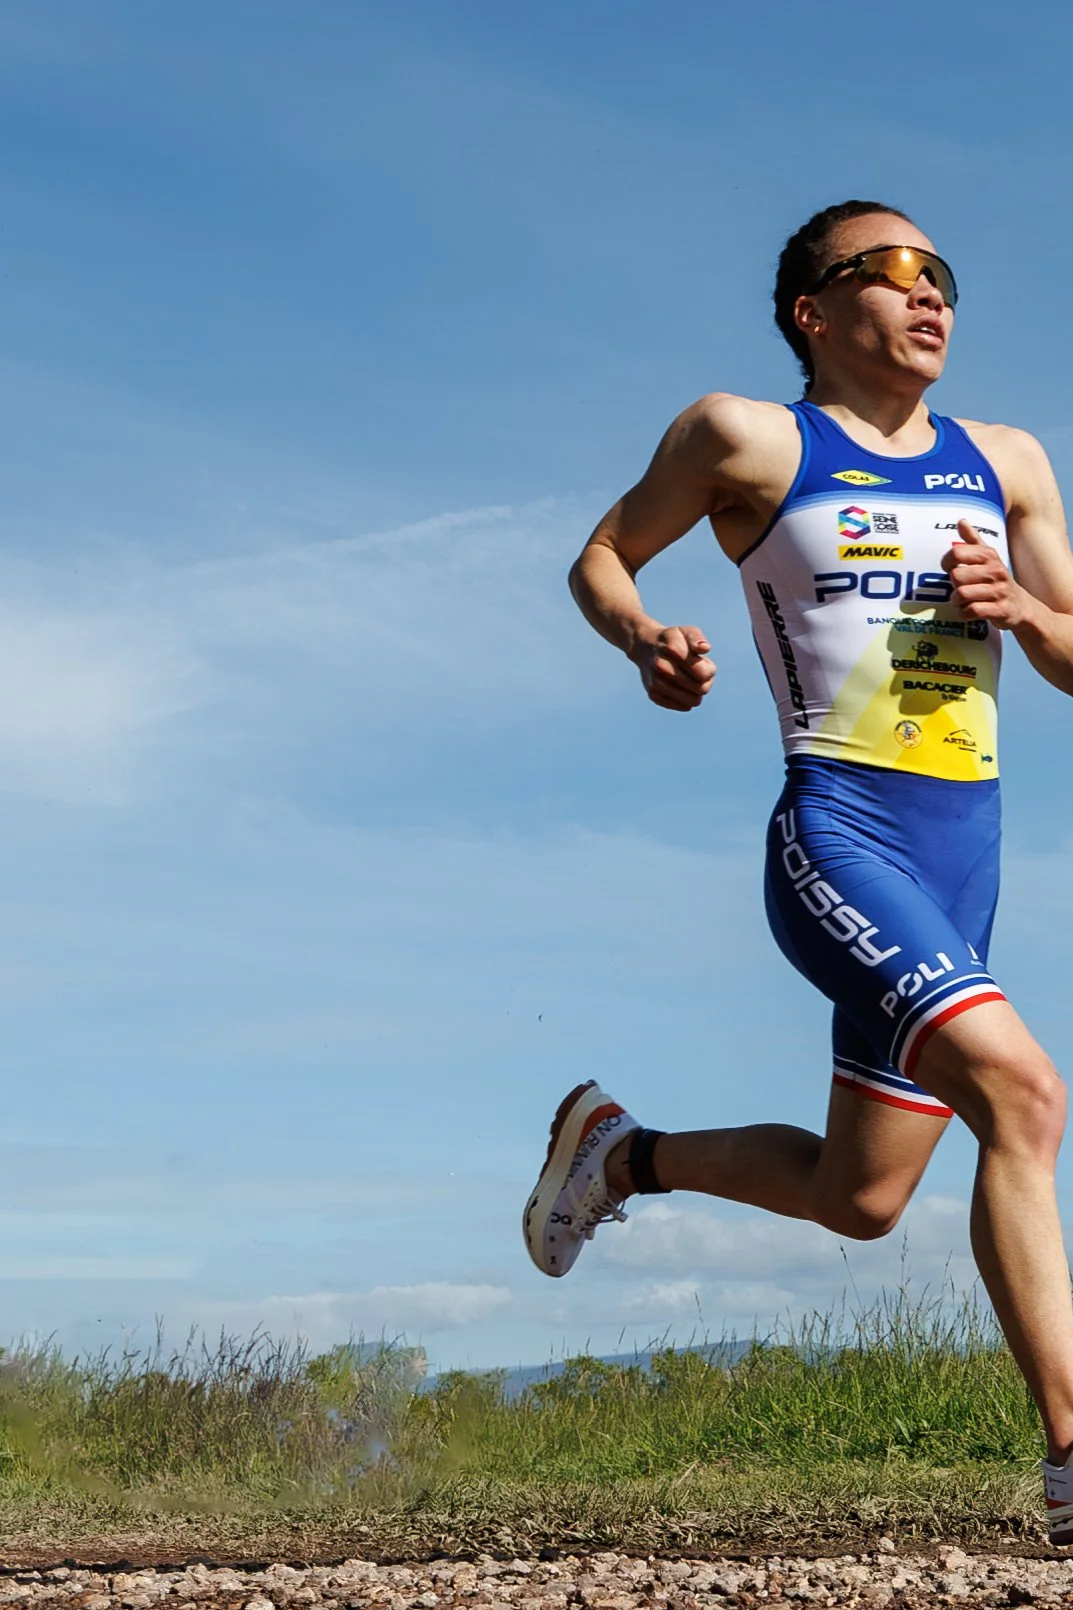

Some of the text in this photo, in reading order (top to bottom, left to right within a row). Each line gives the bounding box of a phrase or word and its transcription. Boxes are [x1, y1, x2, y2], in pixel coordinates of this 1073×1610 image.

[924, 473, 986, 492] POLI
[842, 546, 900, 558] MAVIC
[814, 570, 955, 603] POIS
[891, 659, 977, 676] DERICHEBOURG
[903, 680, 967, 695] BACACIER
[776, 808, 902, 968] POISSY
[880, 952, 955, 1018] POLI
